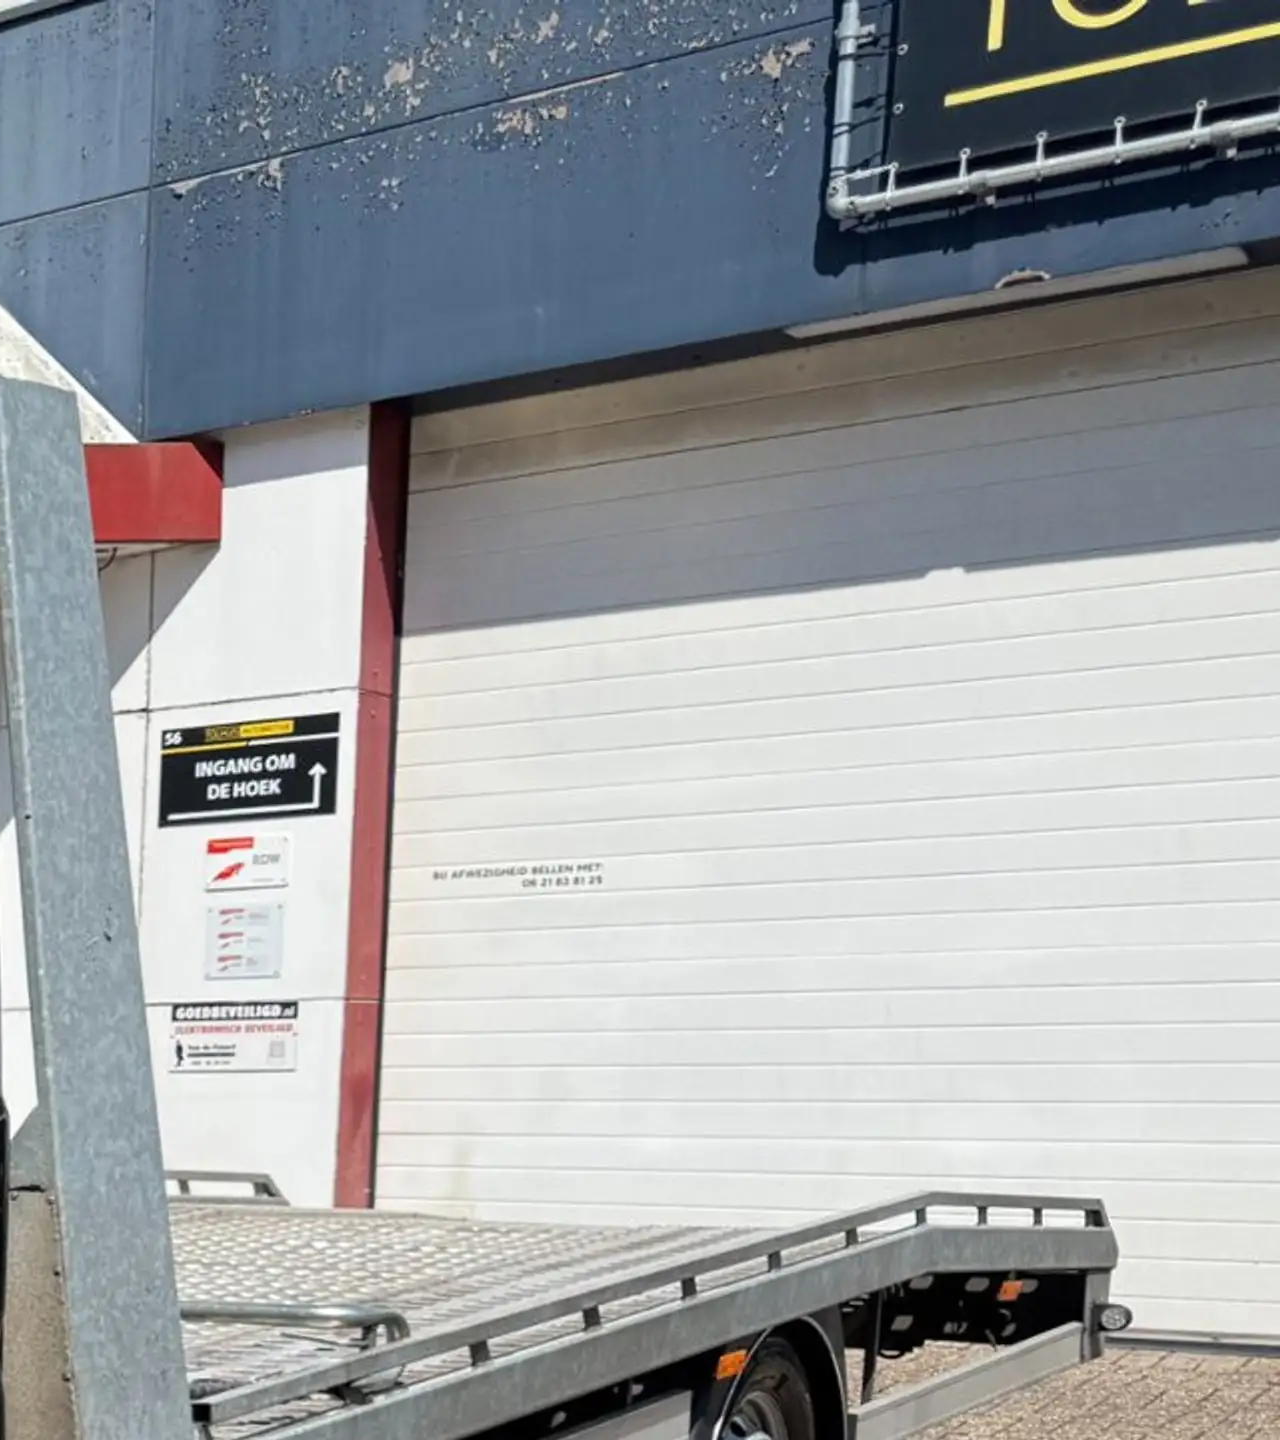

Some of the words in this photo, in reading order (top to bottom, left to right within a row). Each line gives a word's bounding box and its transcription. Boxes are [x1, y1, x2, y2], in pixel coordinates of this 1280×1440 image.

[195, 757, 263, 778] INGANG
[265, 753, 296, 771] OM
[206, 783, 230, 800] DE
[232, 778, 282, 798] HOEK
[252, 853, 281, 865] RDW
[451, 866, 528, 880] AFWEZIGHEID
[531, 863, 574, 875] BELLEN
